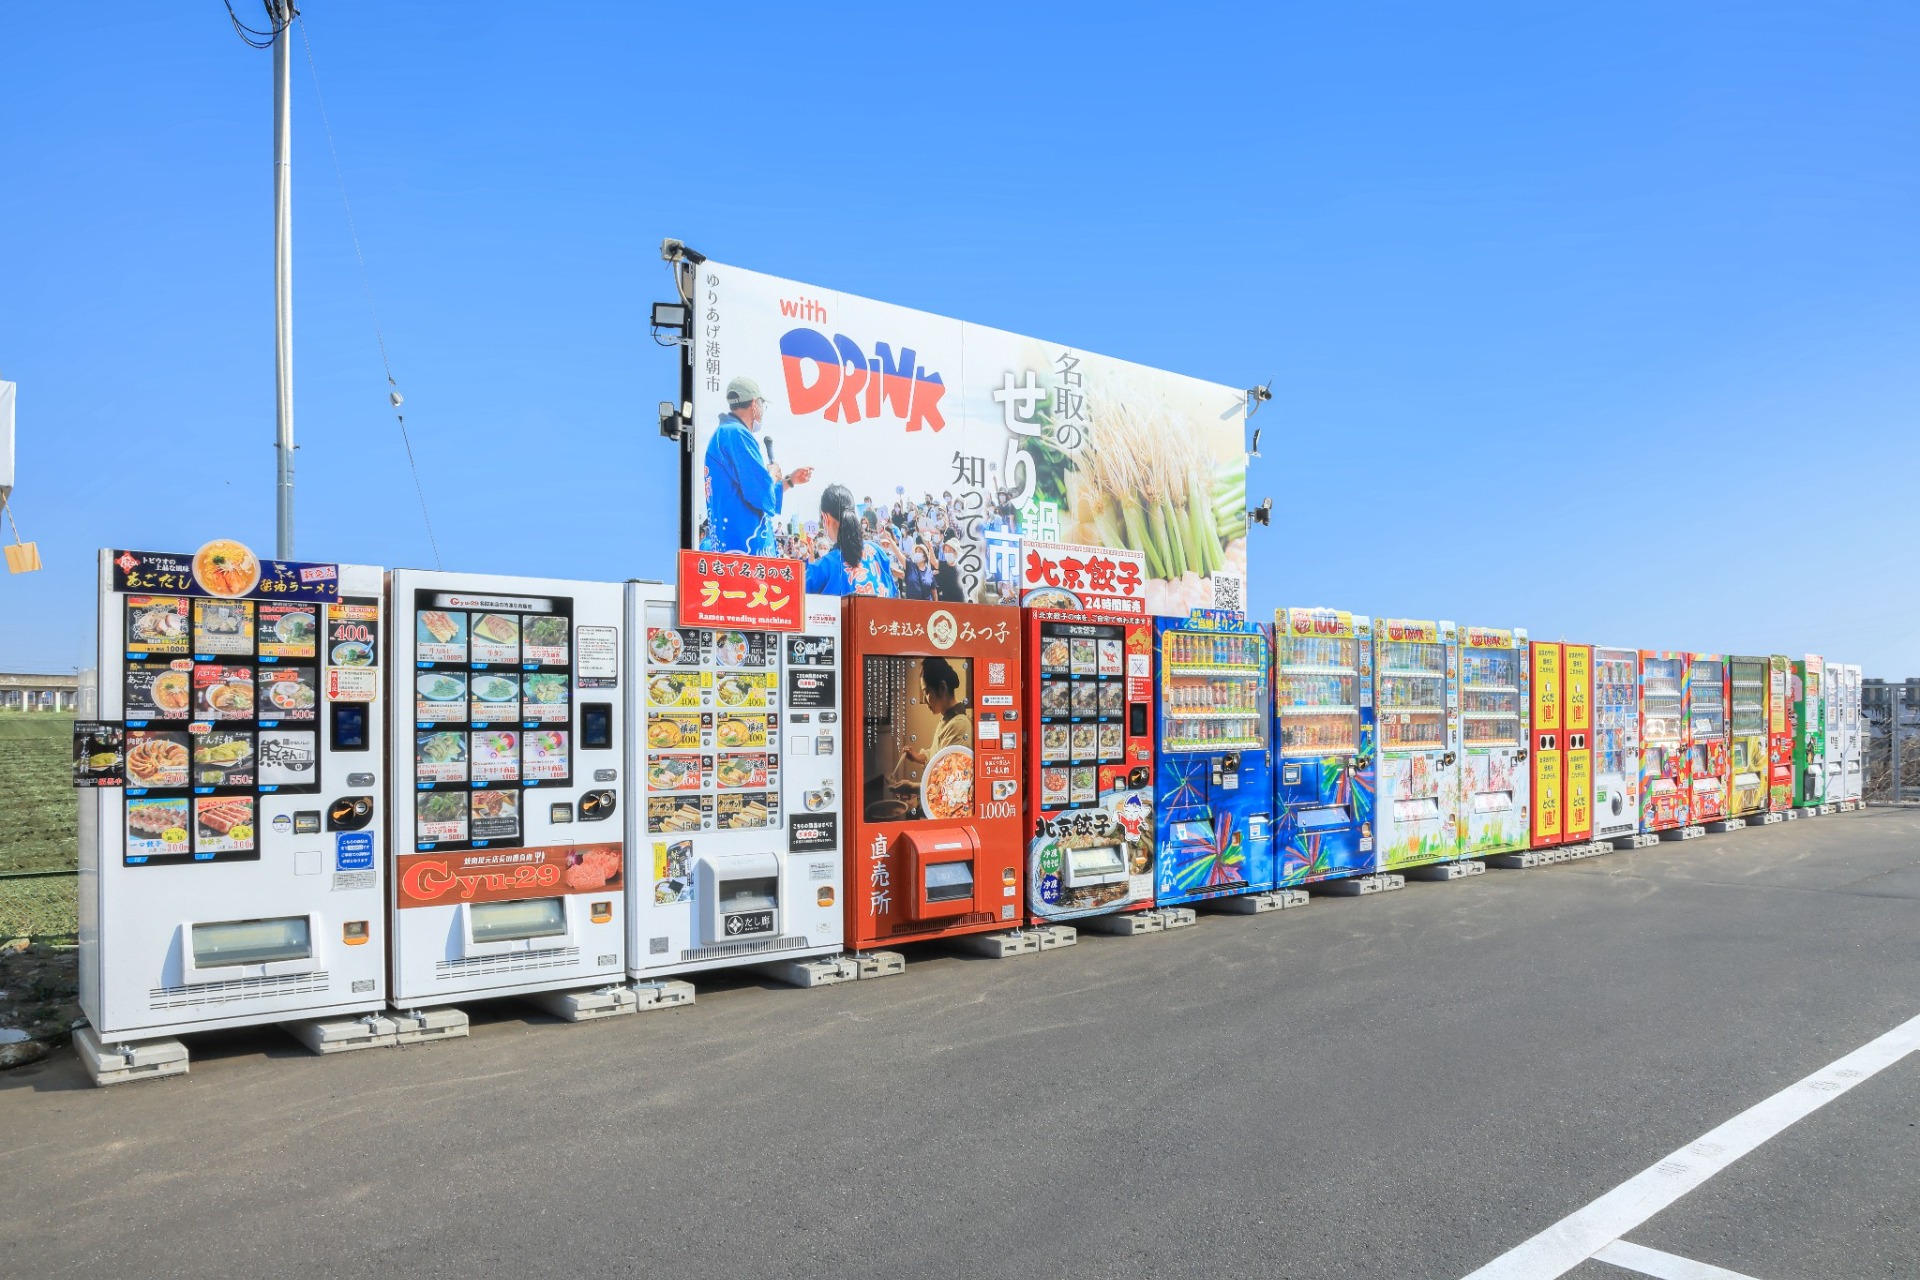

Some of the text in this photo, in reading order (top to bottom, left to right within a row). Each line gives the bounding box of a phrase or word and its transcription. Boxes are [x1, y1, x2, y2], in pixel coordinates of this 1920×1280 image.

[779, 296, 827, 325] with
[706, 273, 721, 393] ゆりあげ港朝市
[779, 327, 946, 433] DRINK
[1054, 352, 1084, 450] 名取の
[142, 556, 176, 566] トビウオの
[698, 557, 795, 583] 自宅で名店の味
[1025, 549, 1143, 596] 北京餃子
[126, 571, 193, 591] あごだし
[260, 577, 339, 595] 醤油ラーメン
[700, 581, 790, 612] ラーメン
[1085, 596, 1142, 613] 24時間販売
[698, 612, 792, 626] Ramen vending machines
[869, 619, 925, 637] もつ煮込み
[960, 621, 1010, 643] みつ子
[1035, 812, 1111, 838] 北京餃子
[402, 860, 561, 900] Gyu-29
[870, 832, 892, 917] 直売所
